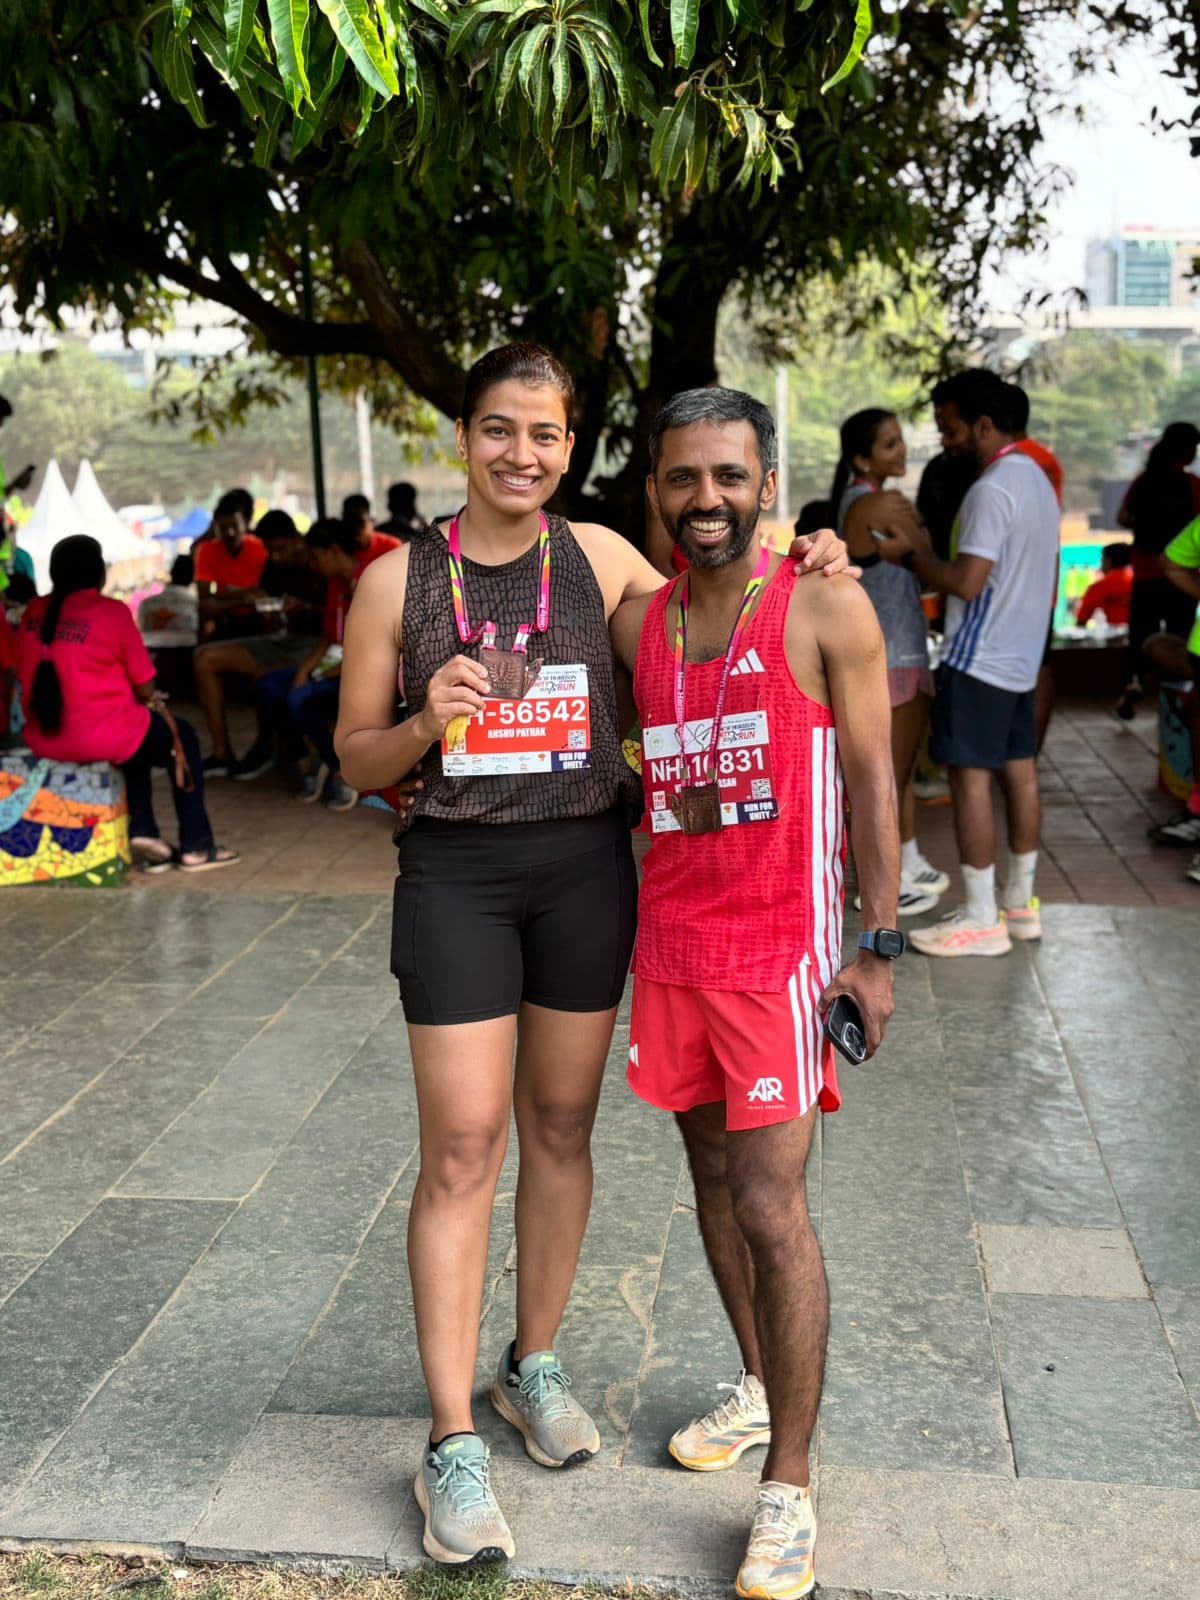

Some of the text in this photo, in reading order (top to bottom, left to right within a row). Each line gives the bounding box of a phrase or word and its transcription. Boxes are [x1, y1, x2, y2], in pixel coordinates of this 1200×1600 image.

[557, 682, 577, 692] RUN
[487, 727, 547, 739] ANSHU PATHAK
[558, 751, 587, 761] RUN FOR
[562, 760, 583, 770] UNITY
[743, 801, 774, 813] RUN FOR
[749, 811, 770, 821] UNITY
